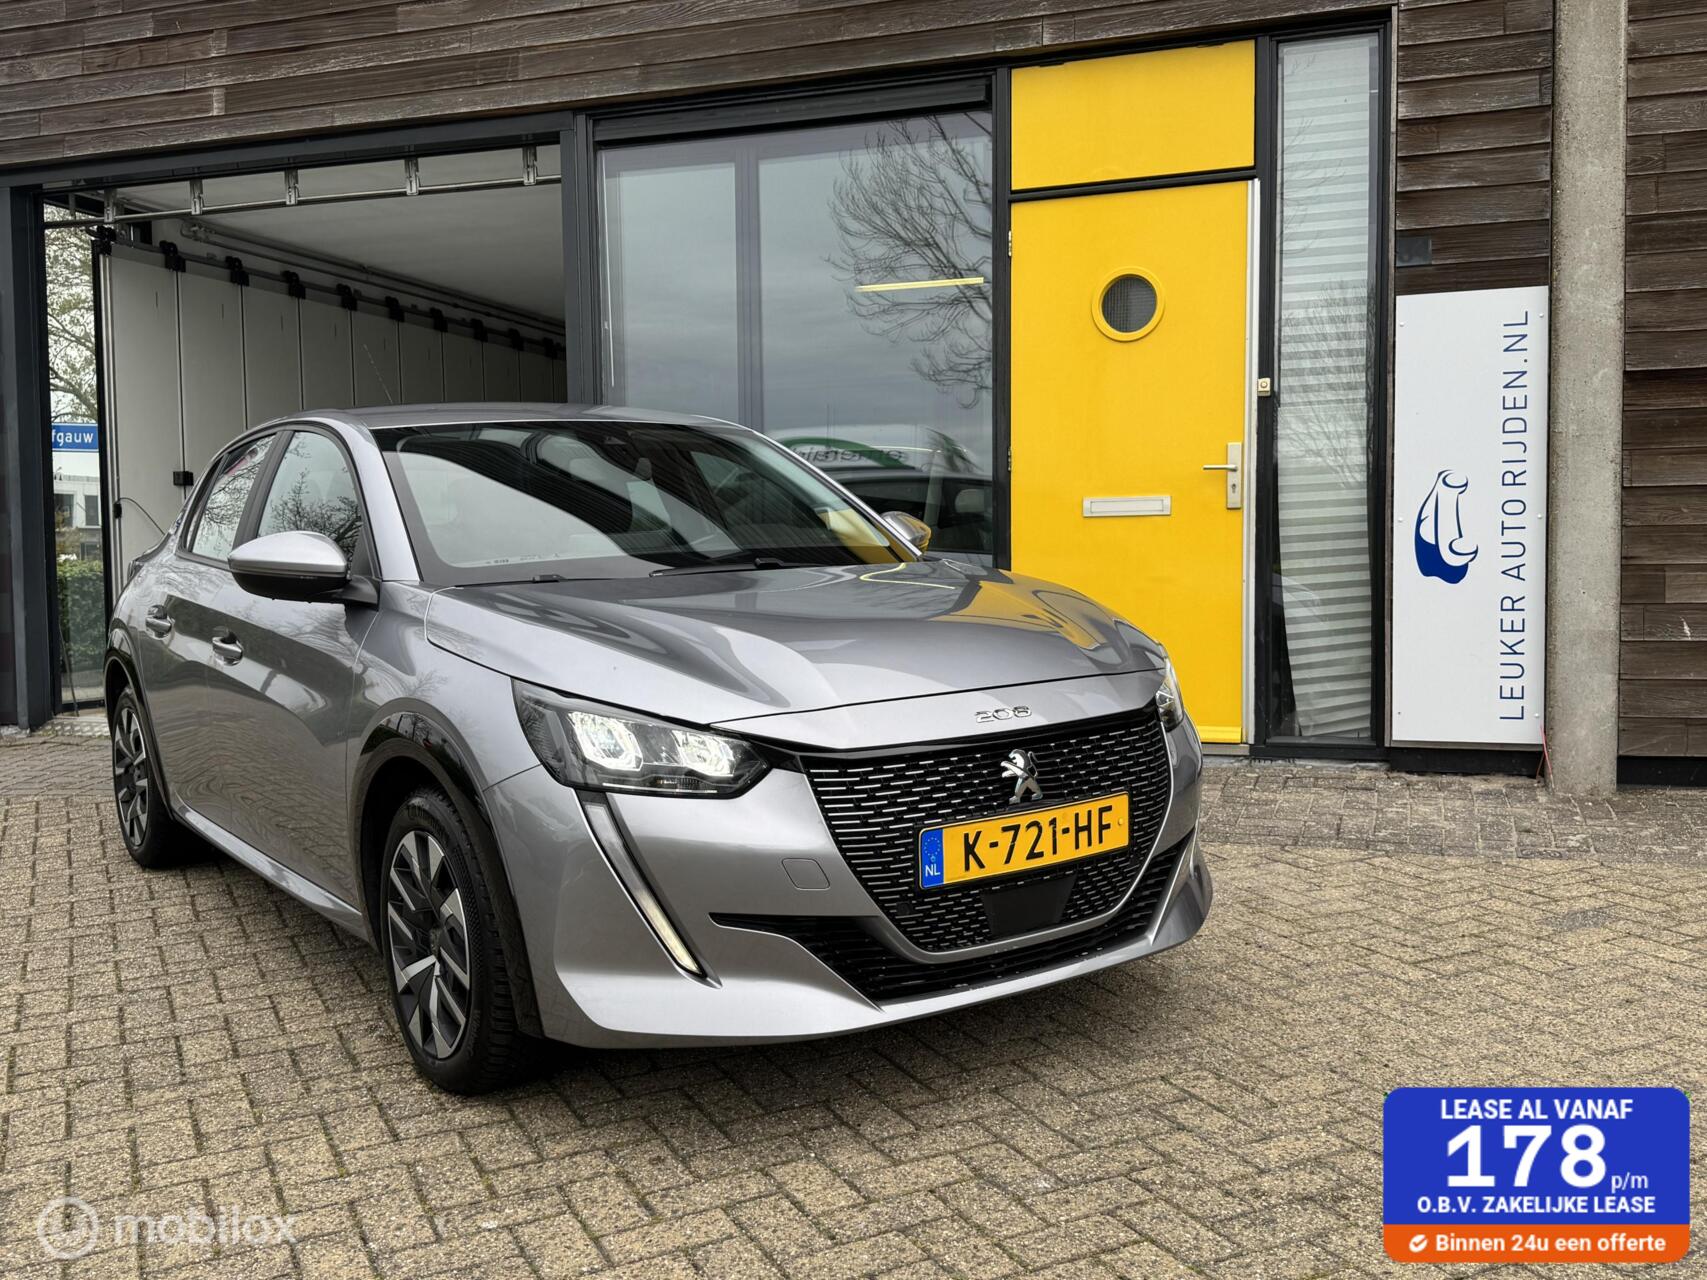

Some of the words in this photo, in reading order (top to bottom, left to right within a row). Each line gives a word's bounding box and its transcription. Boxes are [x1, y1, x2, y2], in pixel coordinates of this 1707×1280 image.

[1501, 310, 1529, 486] RIJDEN.NL
[51, 429, 94, 447] fgauw
[1501, 498, 1527, 582] AUTO
[1499, 594, 1526, 721] LEUKER
[974, 705, 1033, 724] 208
[924, 864, 941, 878] NL
[963, 805, 1113, 872] K-721-HF
